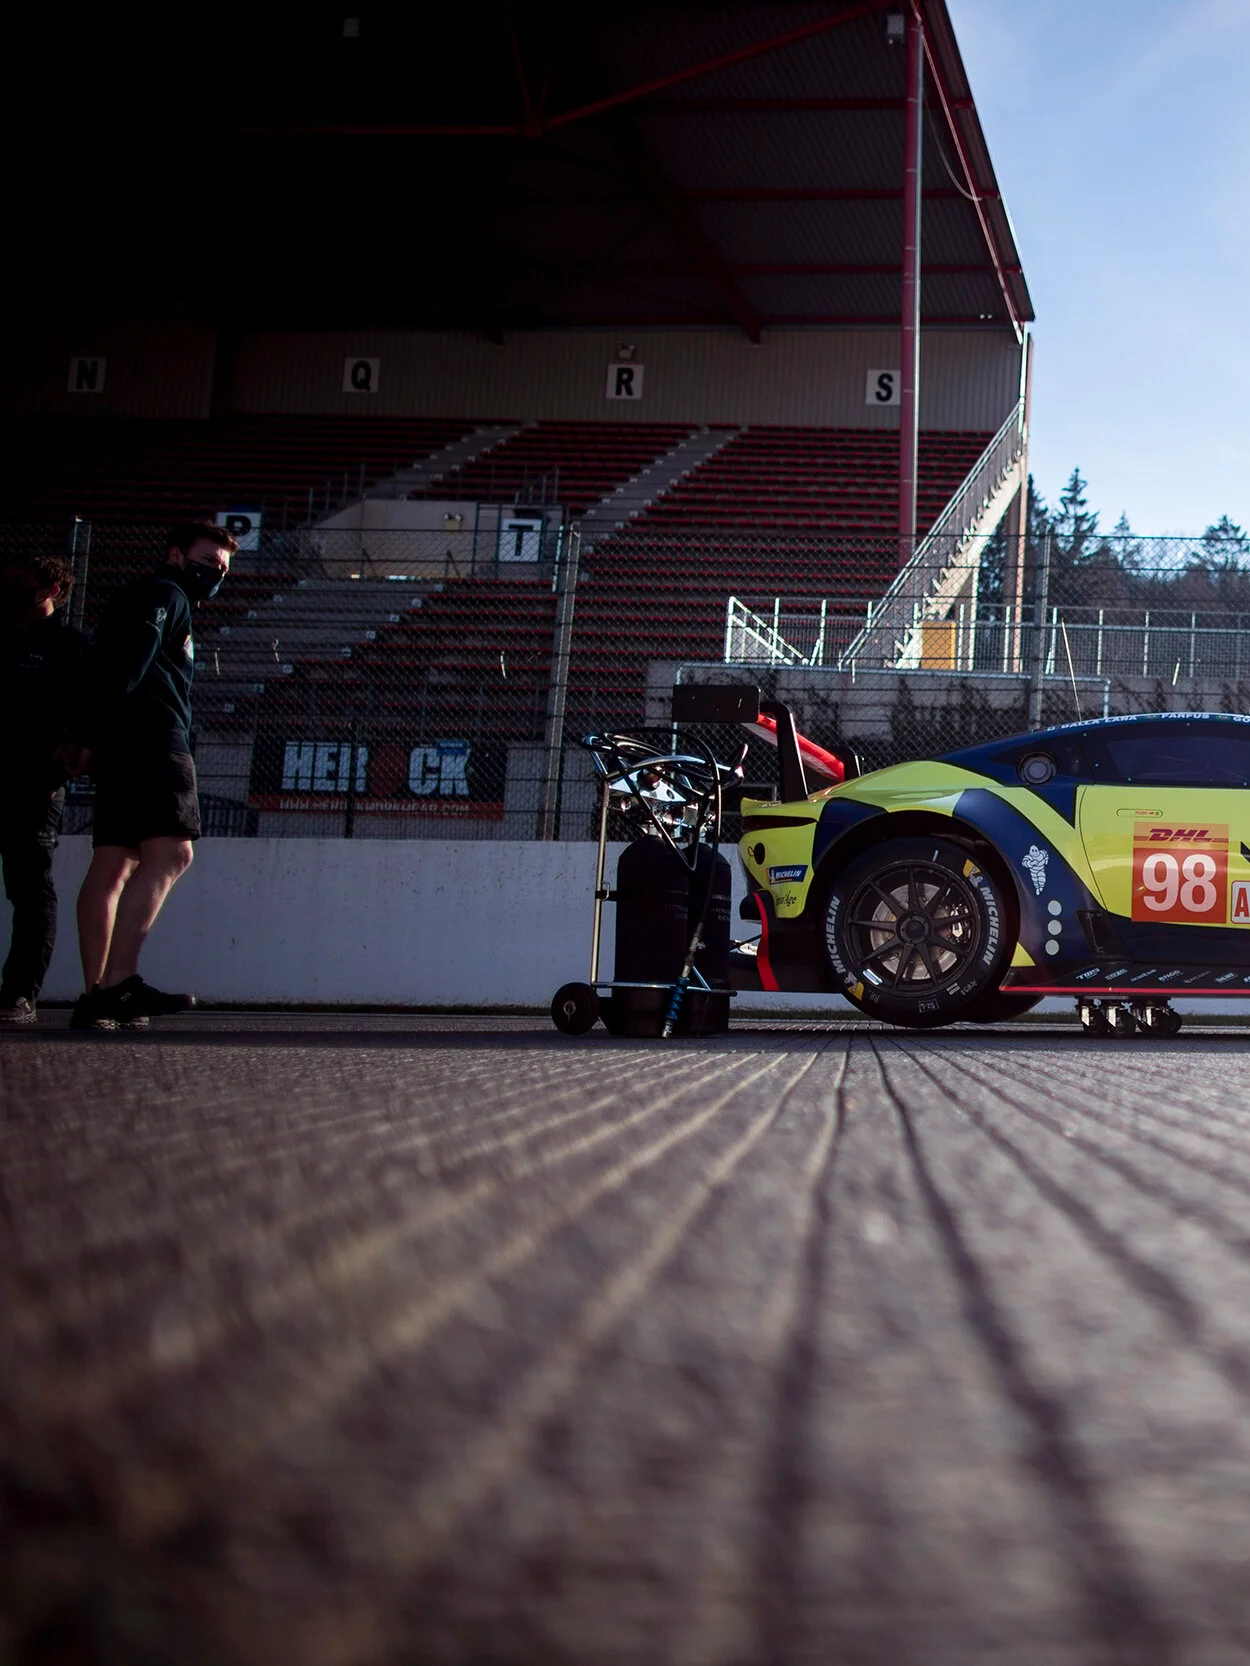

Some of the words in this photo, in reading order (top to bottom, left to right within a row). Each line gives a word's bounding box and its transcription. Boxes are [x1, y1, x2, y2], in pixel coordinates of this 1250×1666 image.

[76, 360, 98, 390] N
[351, 360, 372, 390] Q
[615, 367, 634, 396] R
[875, 373, 894, 402] S
[508, 523, 534, 556] T
[1149, 828, 1213, 842] DHL
[775, 870, 802, 879] MICHELIN
[1142, 852, 1217, 913] 98
[825, 895, 847, 974] MICHELIN
[979, 886, 1000, 967] MICHELIN
